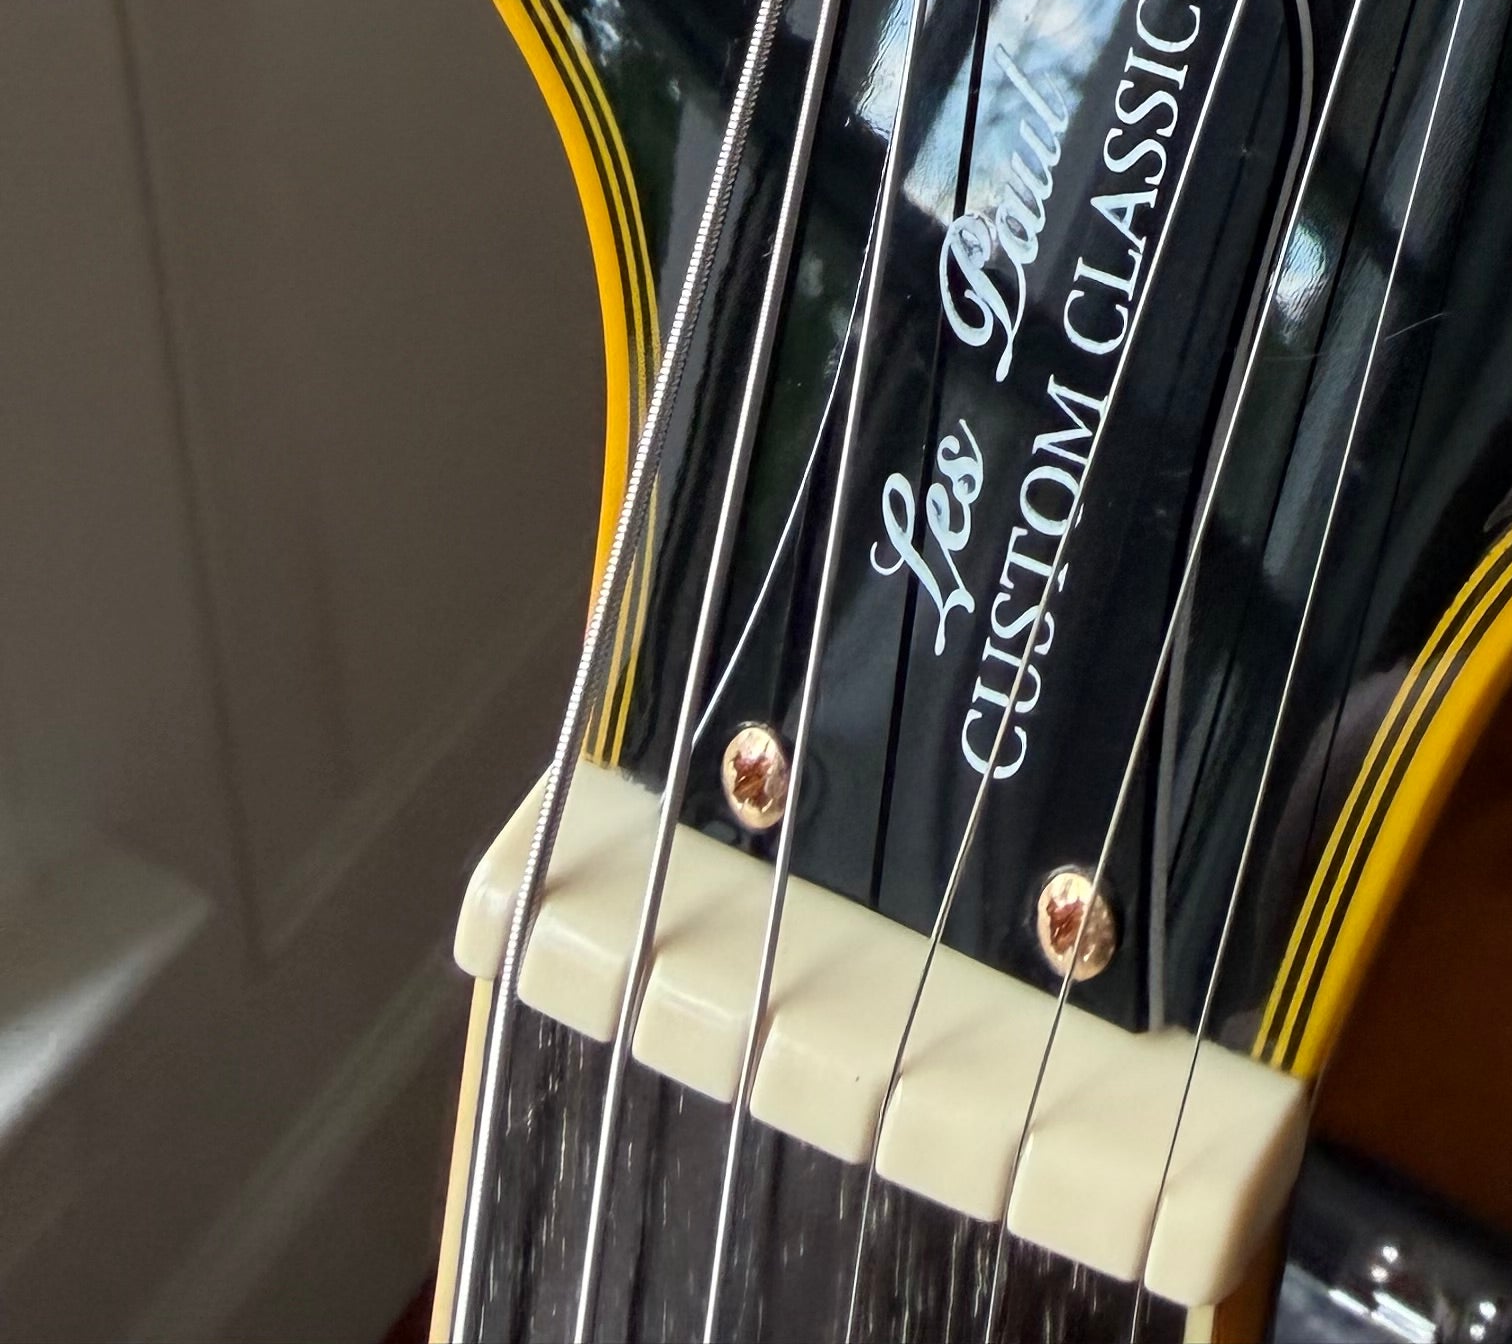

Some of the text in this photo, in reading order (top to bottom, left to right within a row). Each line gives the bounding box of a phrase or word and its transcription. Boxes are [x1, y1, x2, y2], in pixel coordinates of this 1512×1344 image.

[869, 42, 1071, 657] Les Paul
[960, 372, 1111, 780] CUSTOM
